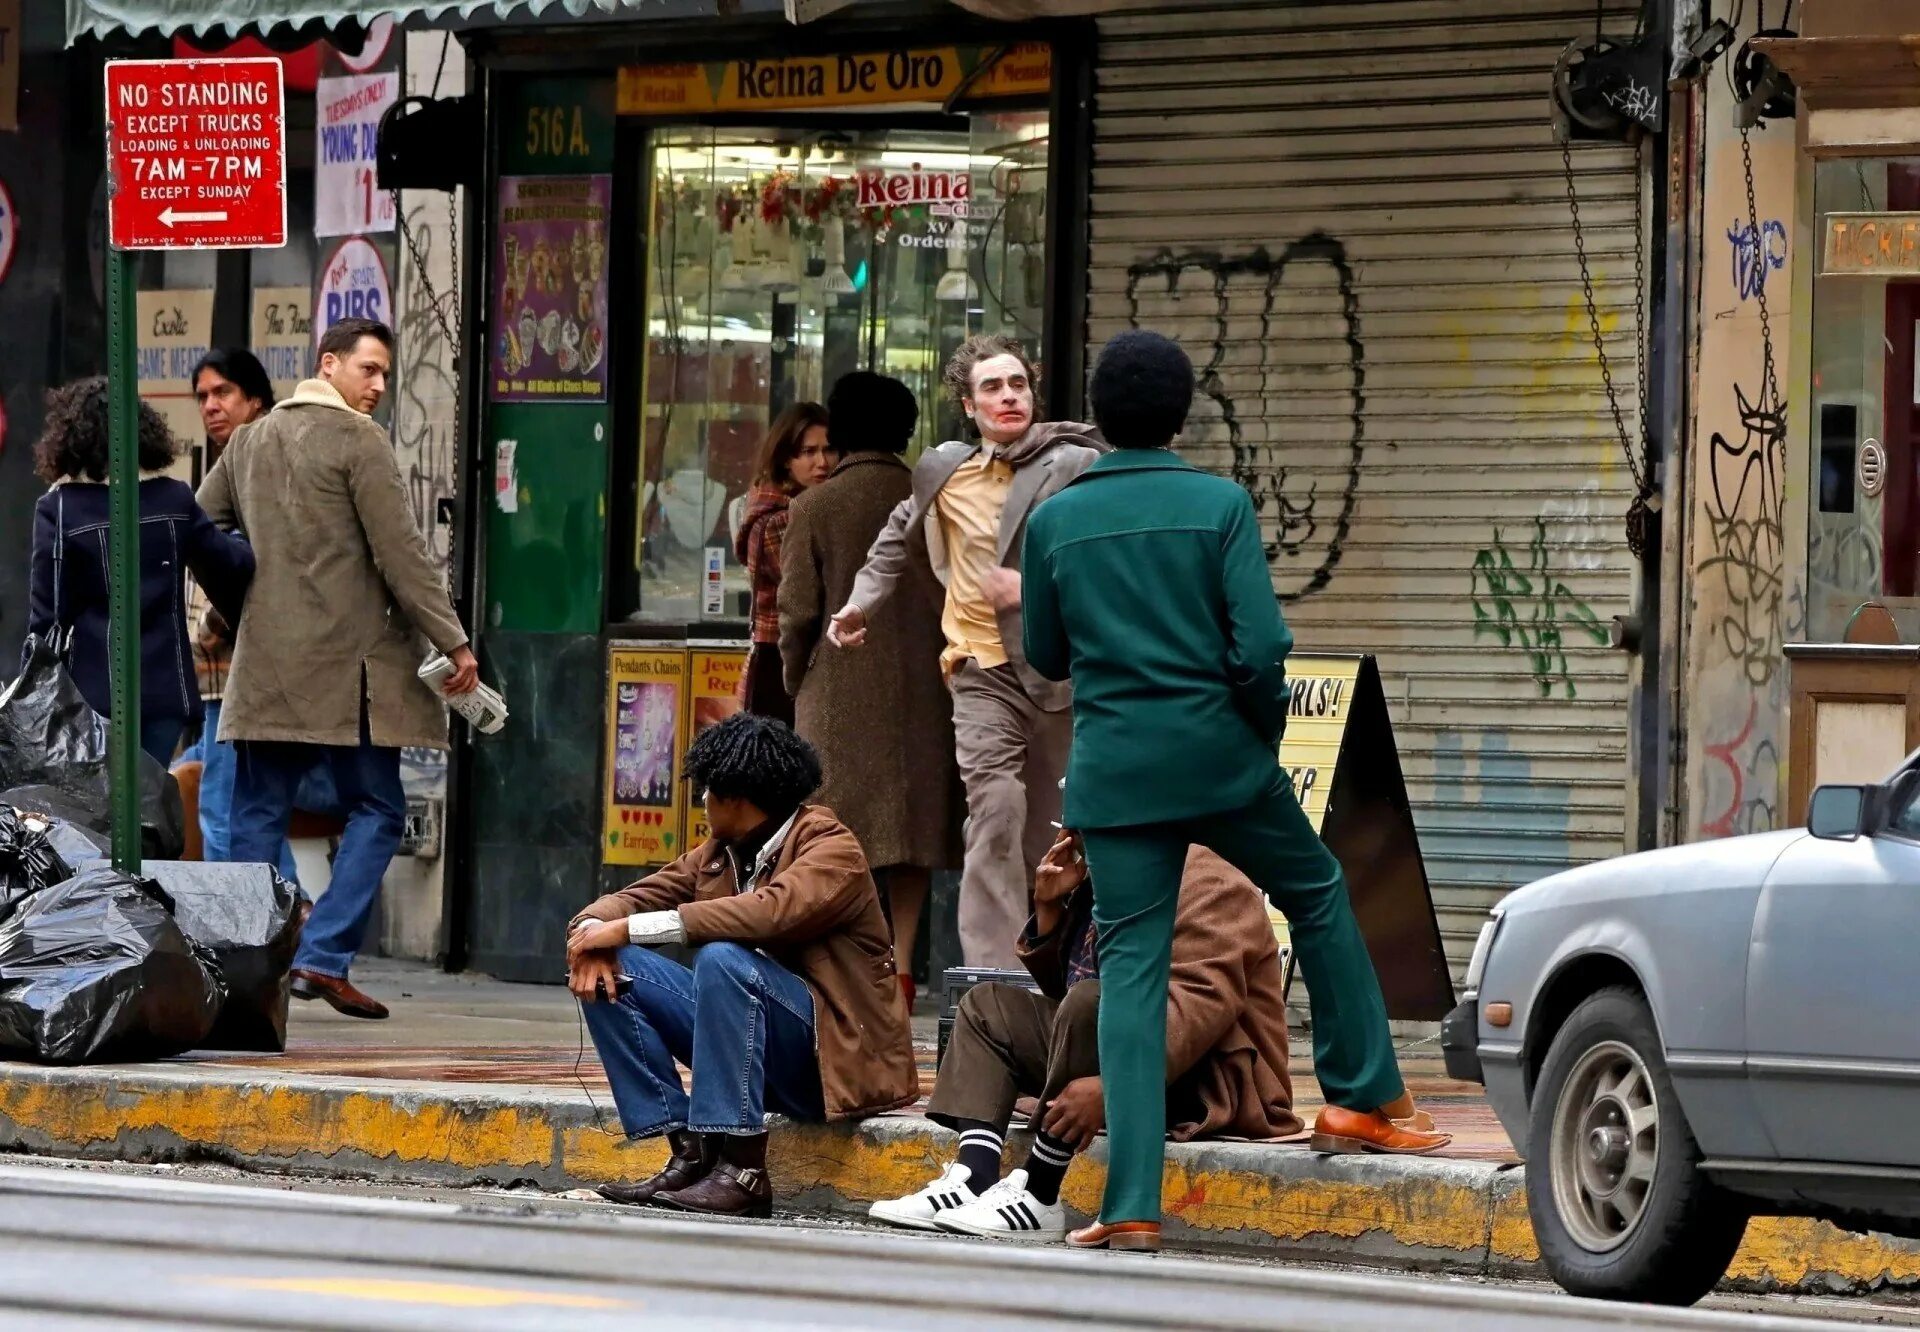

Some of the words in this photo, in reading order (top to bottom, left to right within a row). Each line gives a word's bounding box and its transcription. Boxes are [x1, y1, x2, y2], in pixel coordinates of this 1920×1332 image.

[738, 59, 825, 98] Reina
[837, 55, 877, 94] De
[886, 49, 943, 91] Oro
[120, 83, 148, 107] NO
[161, 82, 268, 107] STANDING
[127, 115, 189, 133] EXCEPT
[198, 114, 262, 132] TRUCKS
[527, 106, 564, 156] 516
[120, 139, 177, 152] LOADING
[183, 142, 190, 150] &
[195, 138, 271, 150] UNLOADING
[322, 124, 357, 164] YOUNG
[141, 187, 191, 199] EXCEPT
[198, 185, 251, 198] SUNDAY
[857, 162, 973, 207] Reina
[185, 235, 264, 243] TRANSPORTATION
[1832, 222, 1920, 266] TICKE
[153, 306, 189, 338] Exotic
[264, 303, 285, 335] The
[654, 658, 681, 675] Chains
[623, 831, 659, 854] Earrings
